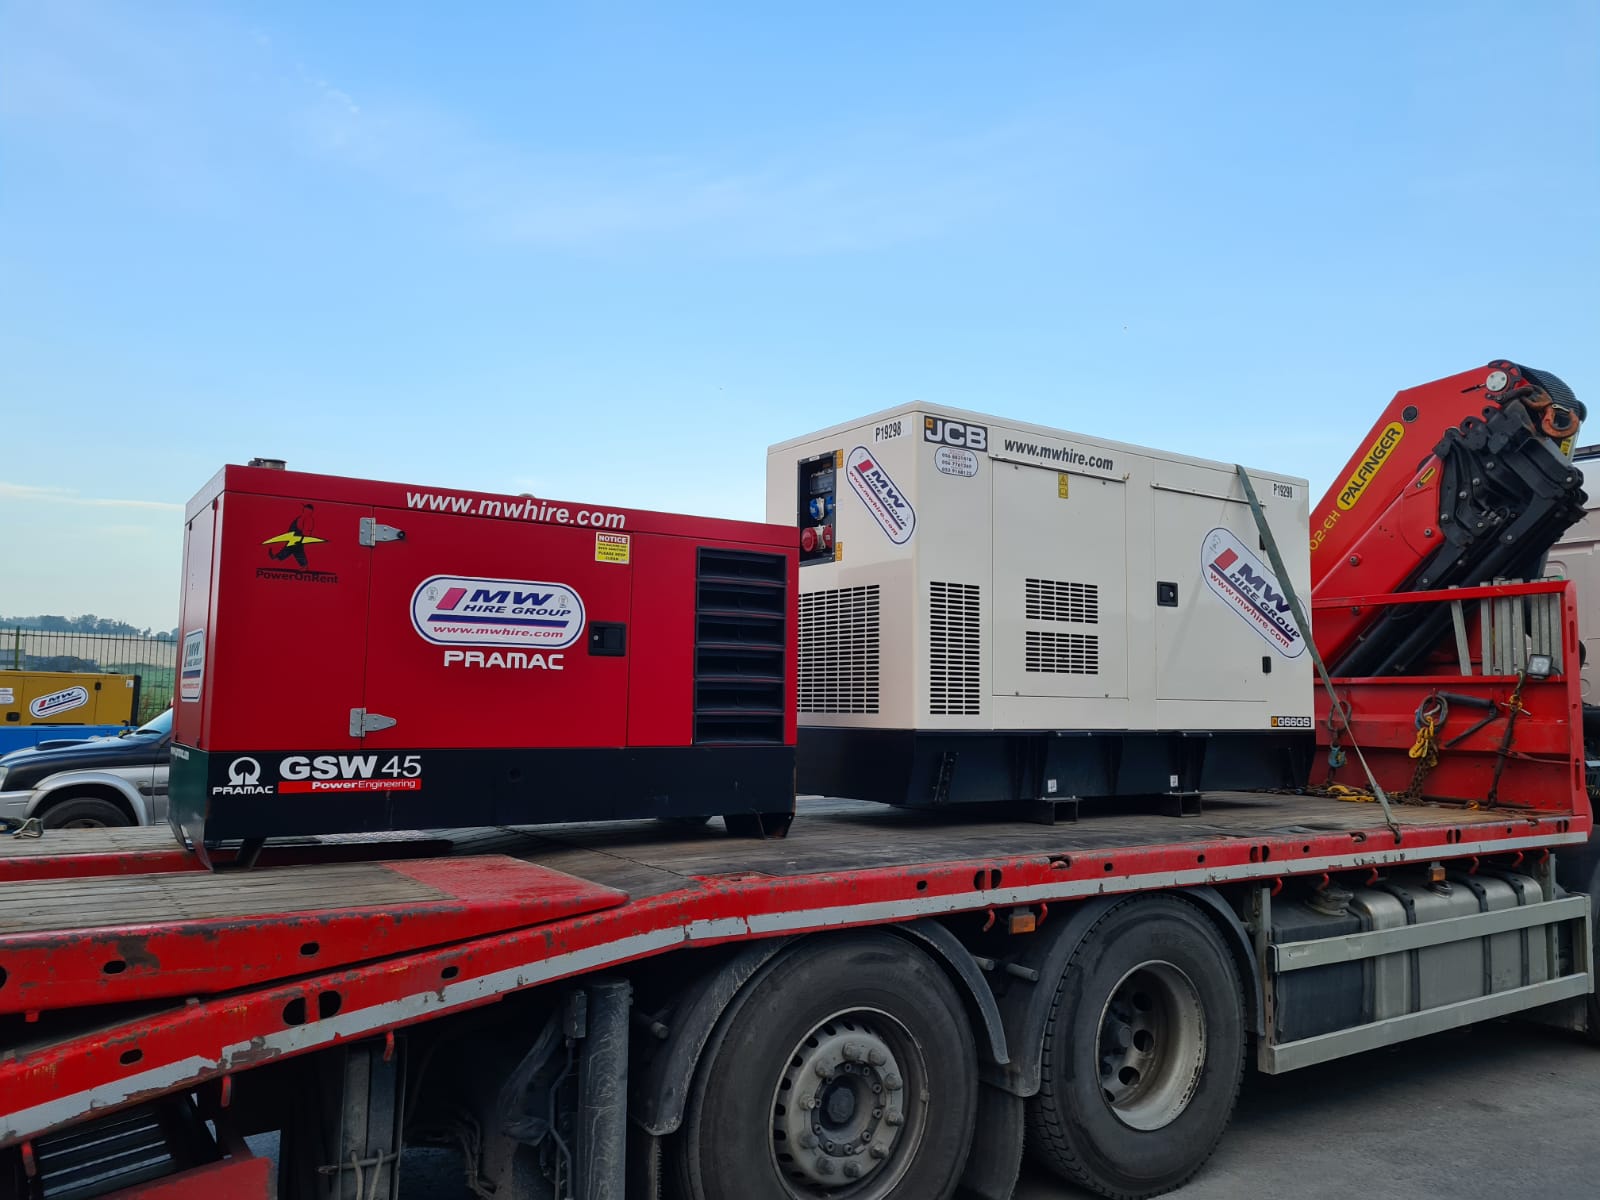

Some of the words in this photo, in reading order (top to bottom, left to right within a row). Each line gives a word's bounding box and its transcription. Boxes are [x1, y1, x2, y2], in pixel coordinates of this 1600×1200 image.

[875, 421, 902, 441] P19298
[926, 419, 987, 450] JCB
[1004, 439, 1113, 471] www.mwhire.com
[1340, 427, 1401, 506] PALFINGER
[849, 470, 898, 536] www.mwhire.com
[866, 474, 883, 495] HIRE
[882, 497, 907, 527] GROUP
[871, 470, 905, 508] MW
[406, 492, 626, 529] www.mwhire.com
[598, 535, 627, 544] NOTICE
[256, 569, 339, 584] PowerOnRent
[1237, 563, 1291, 613] MW
[463, 604, 507, 614] HIRE
[511, 607, 572, 617] GROUP
[469, 589, 555, 607] MW
[1210, 571, 1290, 649] www.mwhire.com
[1229, 573, 1260, 601] HIRE
[1260, 602, 1301, 638] GROUP
[433, 626, 564, 638] www.mwhire.com
[443, 650, 564, 670] PRAMAC
[1277, 717, 1310, 727] G66GS
[279, 755, 378, 780] GSW
[381, 755, 422, 778] 45
[213, 785, 274, 795] PRAMAC
